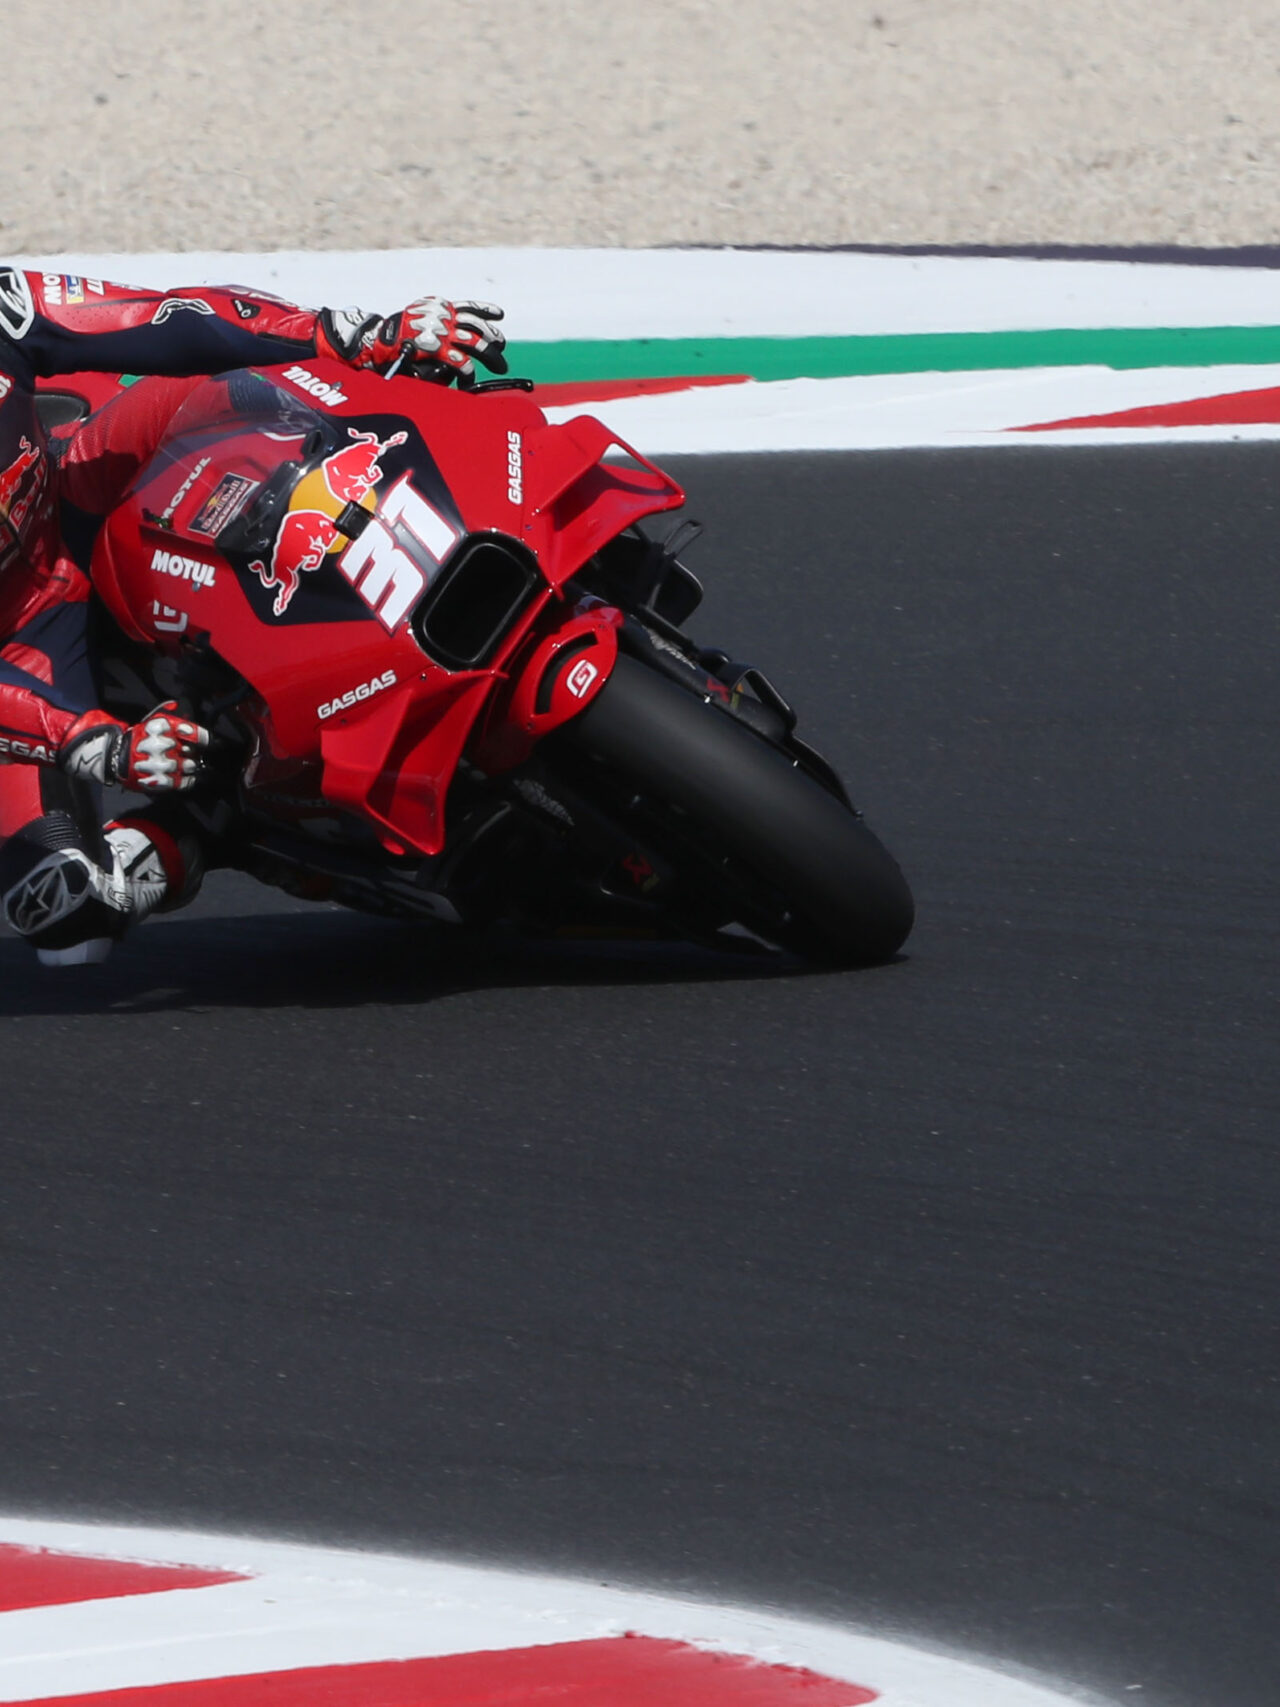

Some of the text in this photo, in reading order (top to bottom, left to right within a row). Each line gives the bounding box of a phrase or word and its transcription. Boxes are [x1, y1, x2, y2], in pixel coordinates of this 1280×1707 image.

[281, 365, 349, 407] MOTUL
[161, 456, 212, 519] MOTUL
[507, 430, 524, 505] GASGAS
[150, 549, 217, 588] MOTUL
[338, 472, 458, 634] 31
[317, 669, 397, 720] GASGAS
